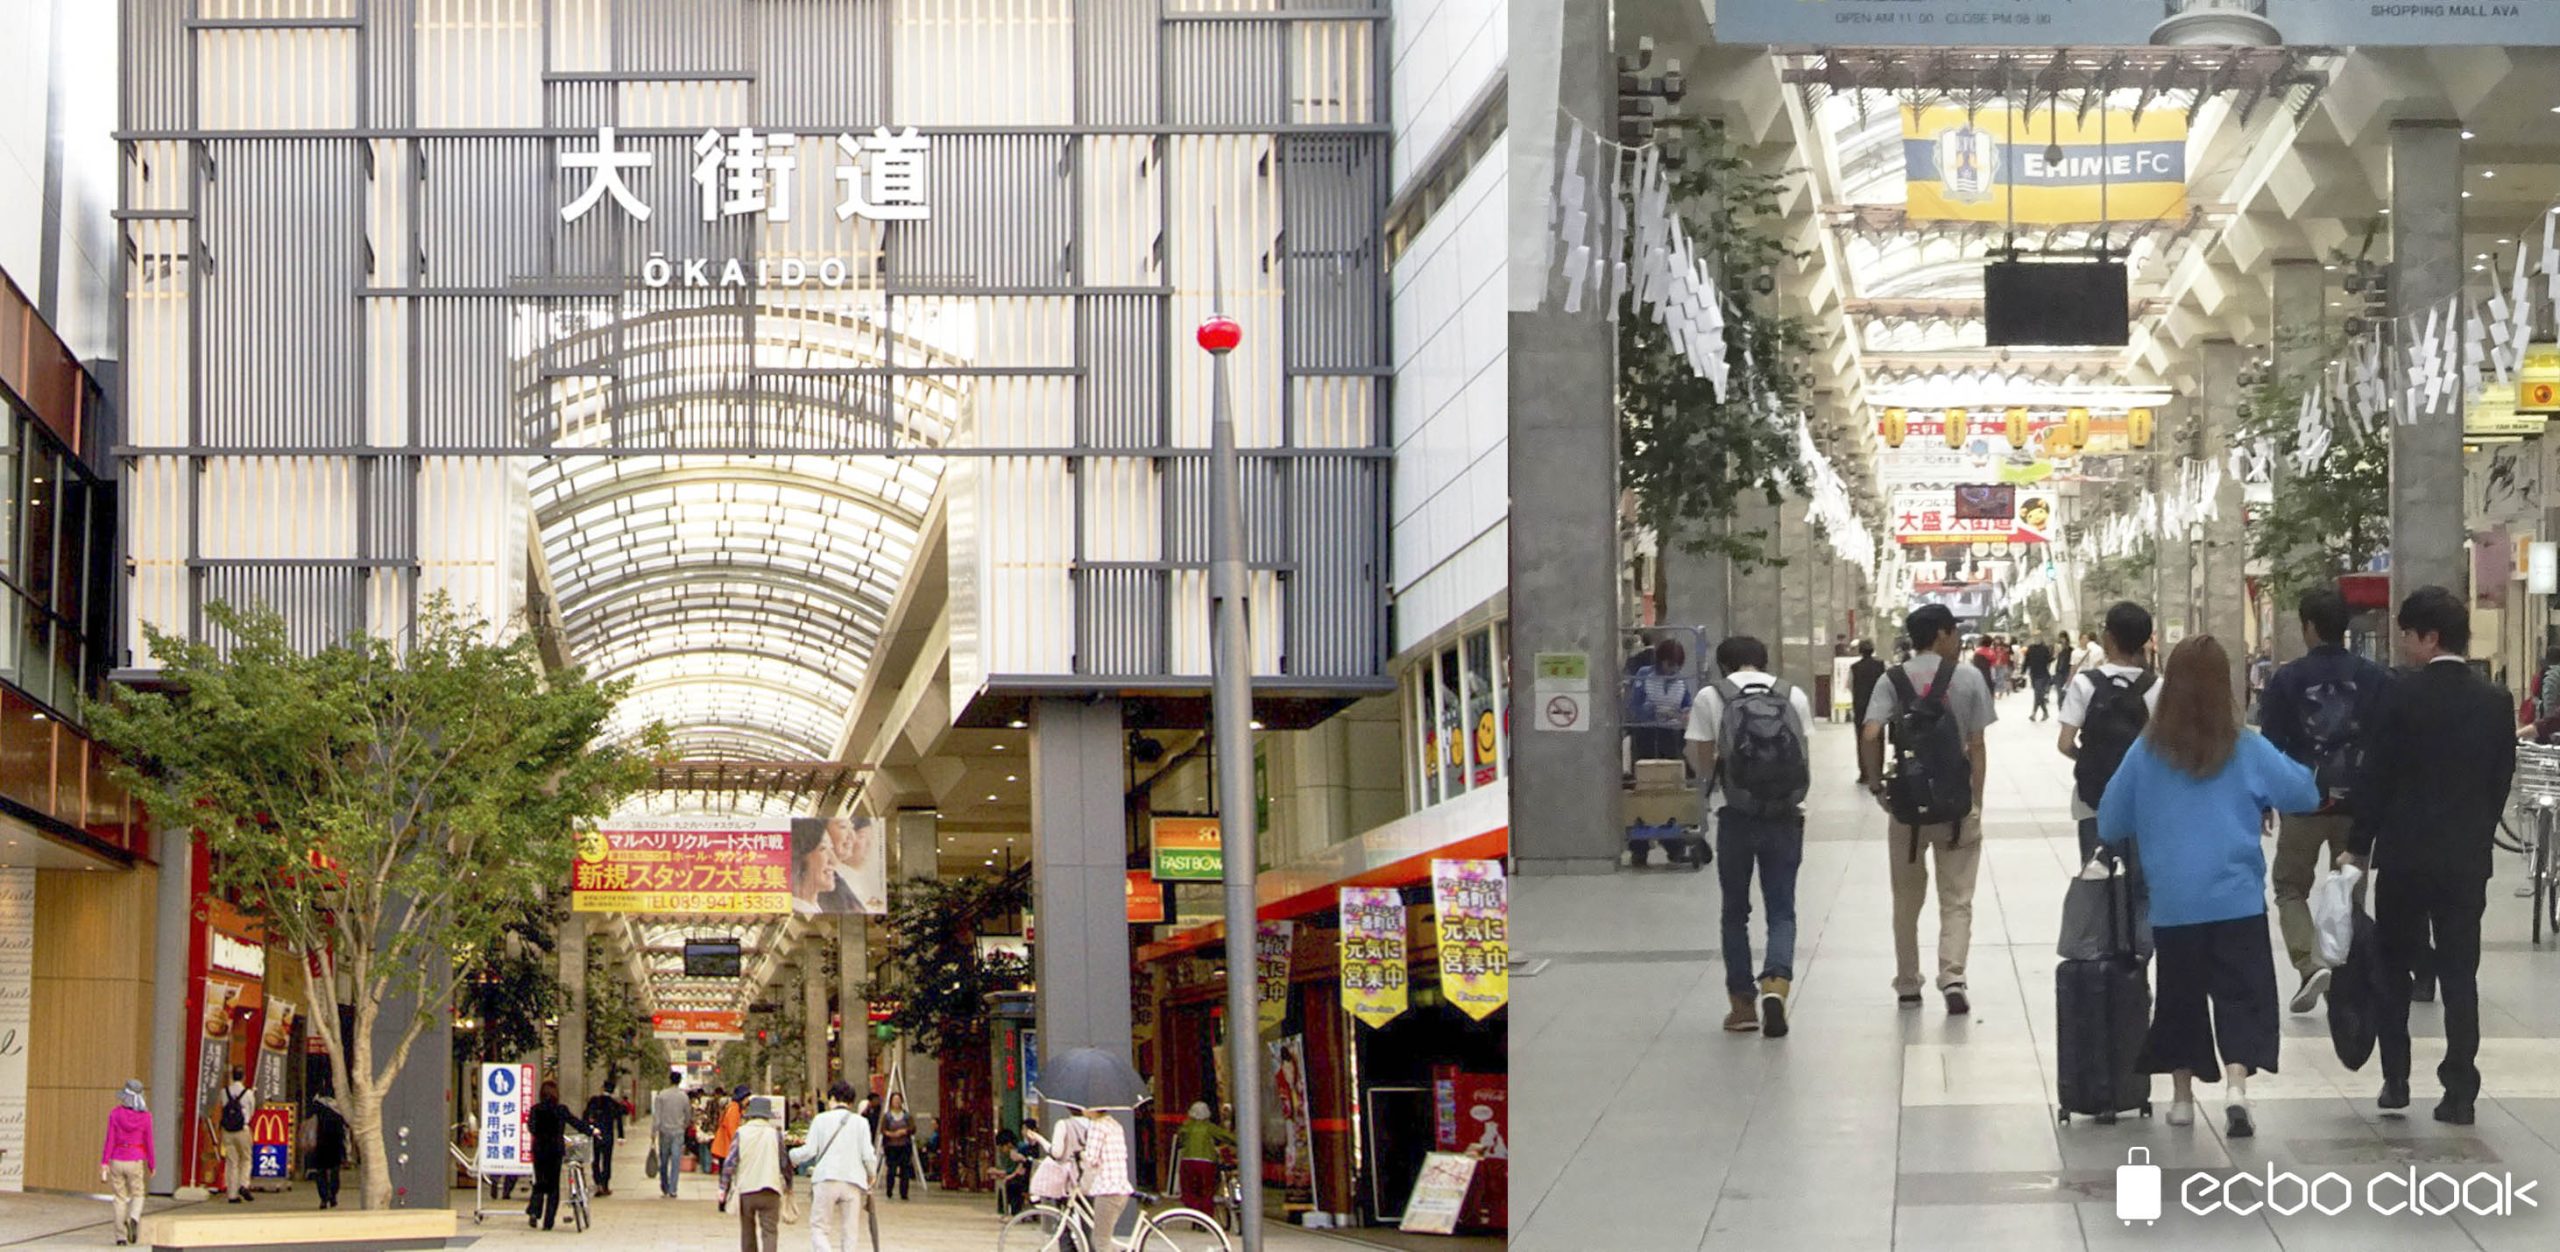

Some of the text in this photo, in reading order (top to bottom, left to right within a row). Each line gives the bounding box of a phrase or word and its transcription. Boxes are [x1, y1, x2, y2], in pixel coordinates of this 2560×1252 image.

[1835, 12, 1871, 24] OPEN
[1875, 12, 1894, 24] AM
[1945, 12, 1988, 24] CLOSE
[2371, 5, 2520, 17] SHOPPING MALL AVA
[560, 126, 931, 223] 大街道
[2023, 152, 2131, 178] EHIME
[643, 252, 847, 287] ŌKAIDO
[1899, 511, 1942, 532] 大盛
[608, 834, 784, 850] マルヘリ リクルート大作戦
[578, 863, 787, 890] 新規スタッフ大募集
[646, 895, 667, 910] TEL
[670, 895, 785, 910] 089-941-5353
[1442, 891, 1501, 909] 一番町店
[1443, 916, 1504, 941] 元気に
[1346, 938, 1401, 960] 元気に
[1441, 946, 1508, 975] 営業中
[1344, 963, 1404, 990] 営業中
[486, 1101, 501, 1160] 専用道路
[502, 1101, 516, 1160] 歩行者
